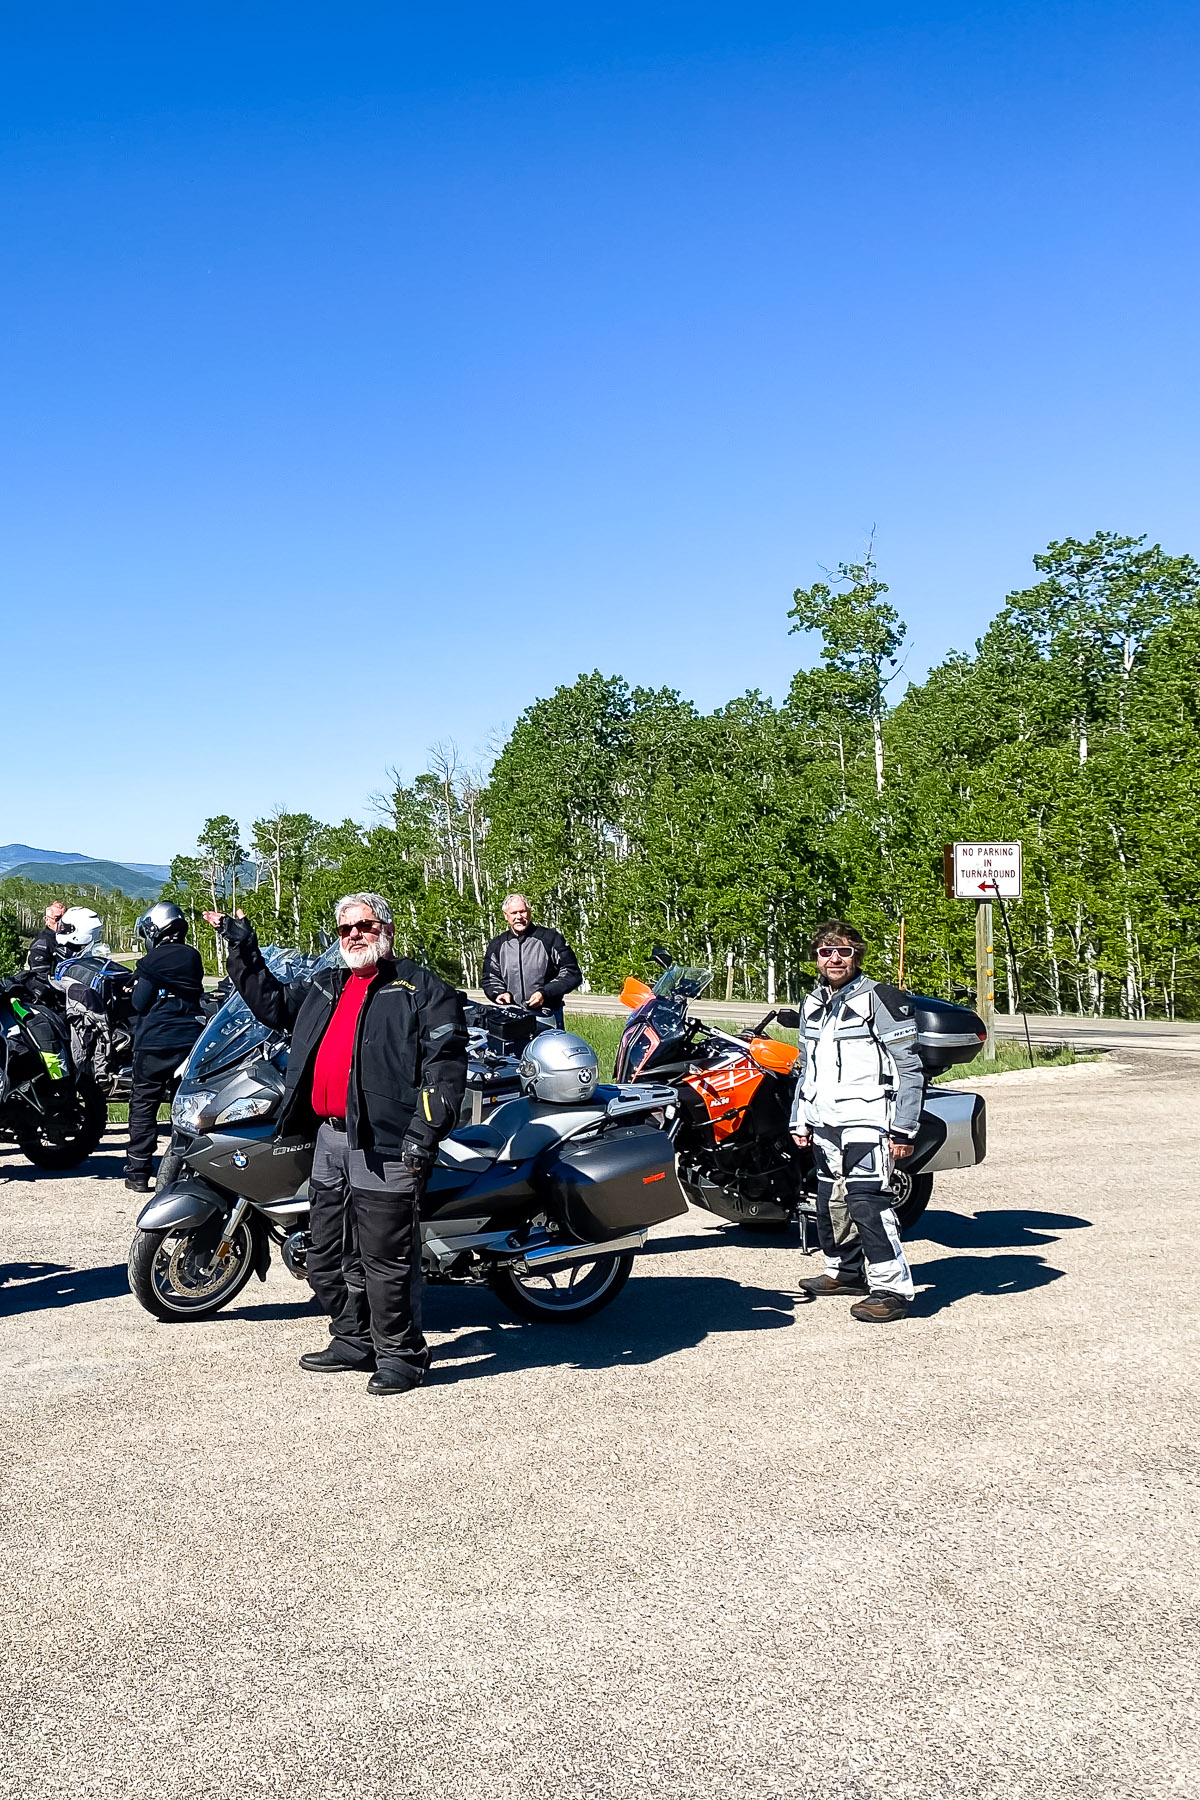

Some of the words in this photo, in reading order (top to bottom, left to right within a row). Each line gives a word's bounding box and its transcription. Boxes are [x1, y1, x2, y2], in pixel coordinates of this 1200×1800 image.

[962, 848, 973, 856] NO
[977, 848, 1014, 856] PARKING
[983, 859, 992, 867] IN
[960, 869, 1016, 878] TURNAROUND
